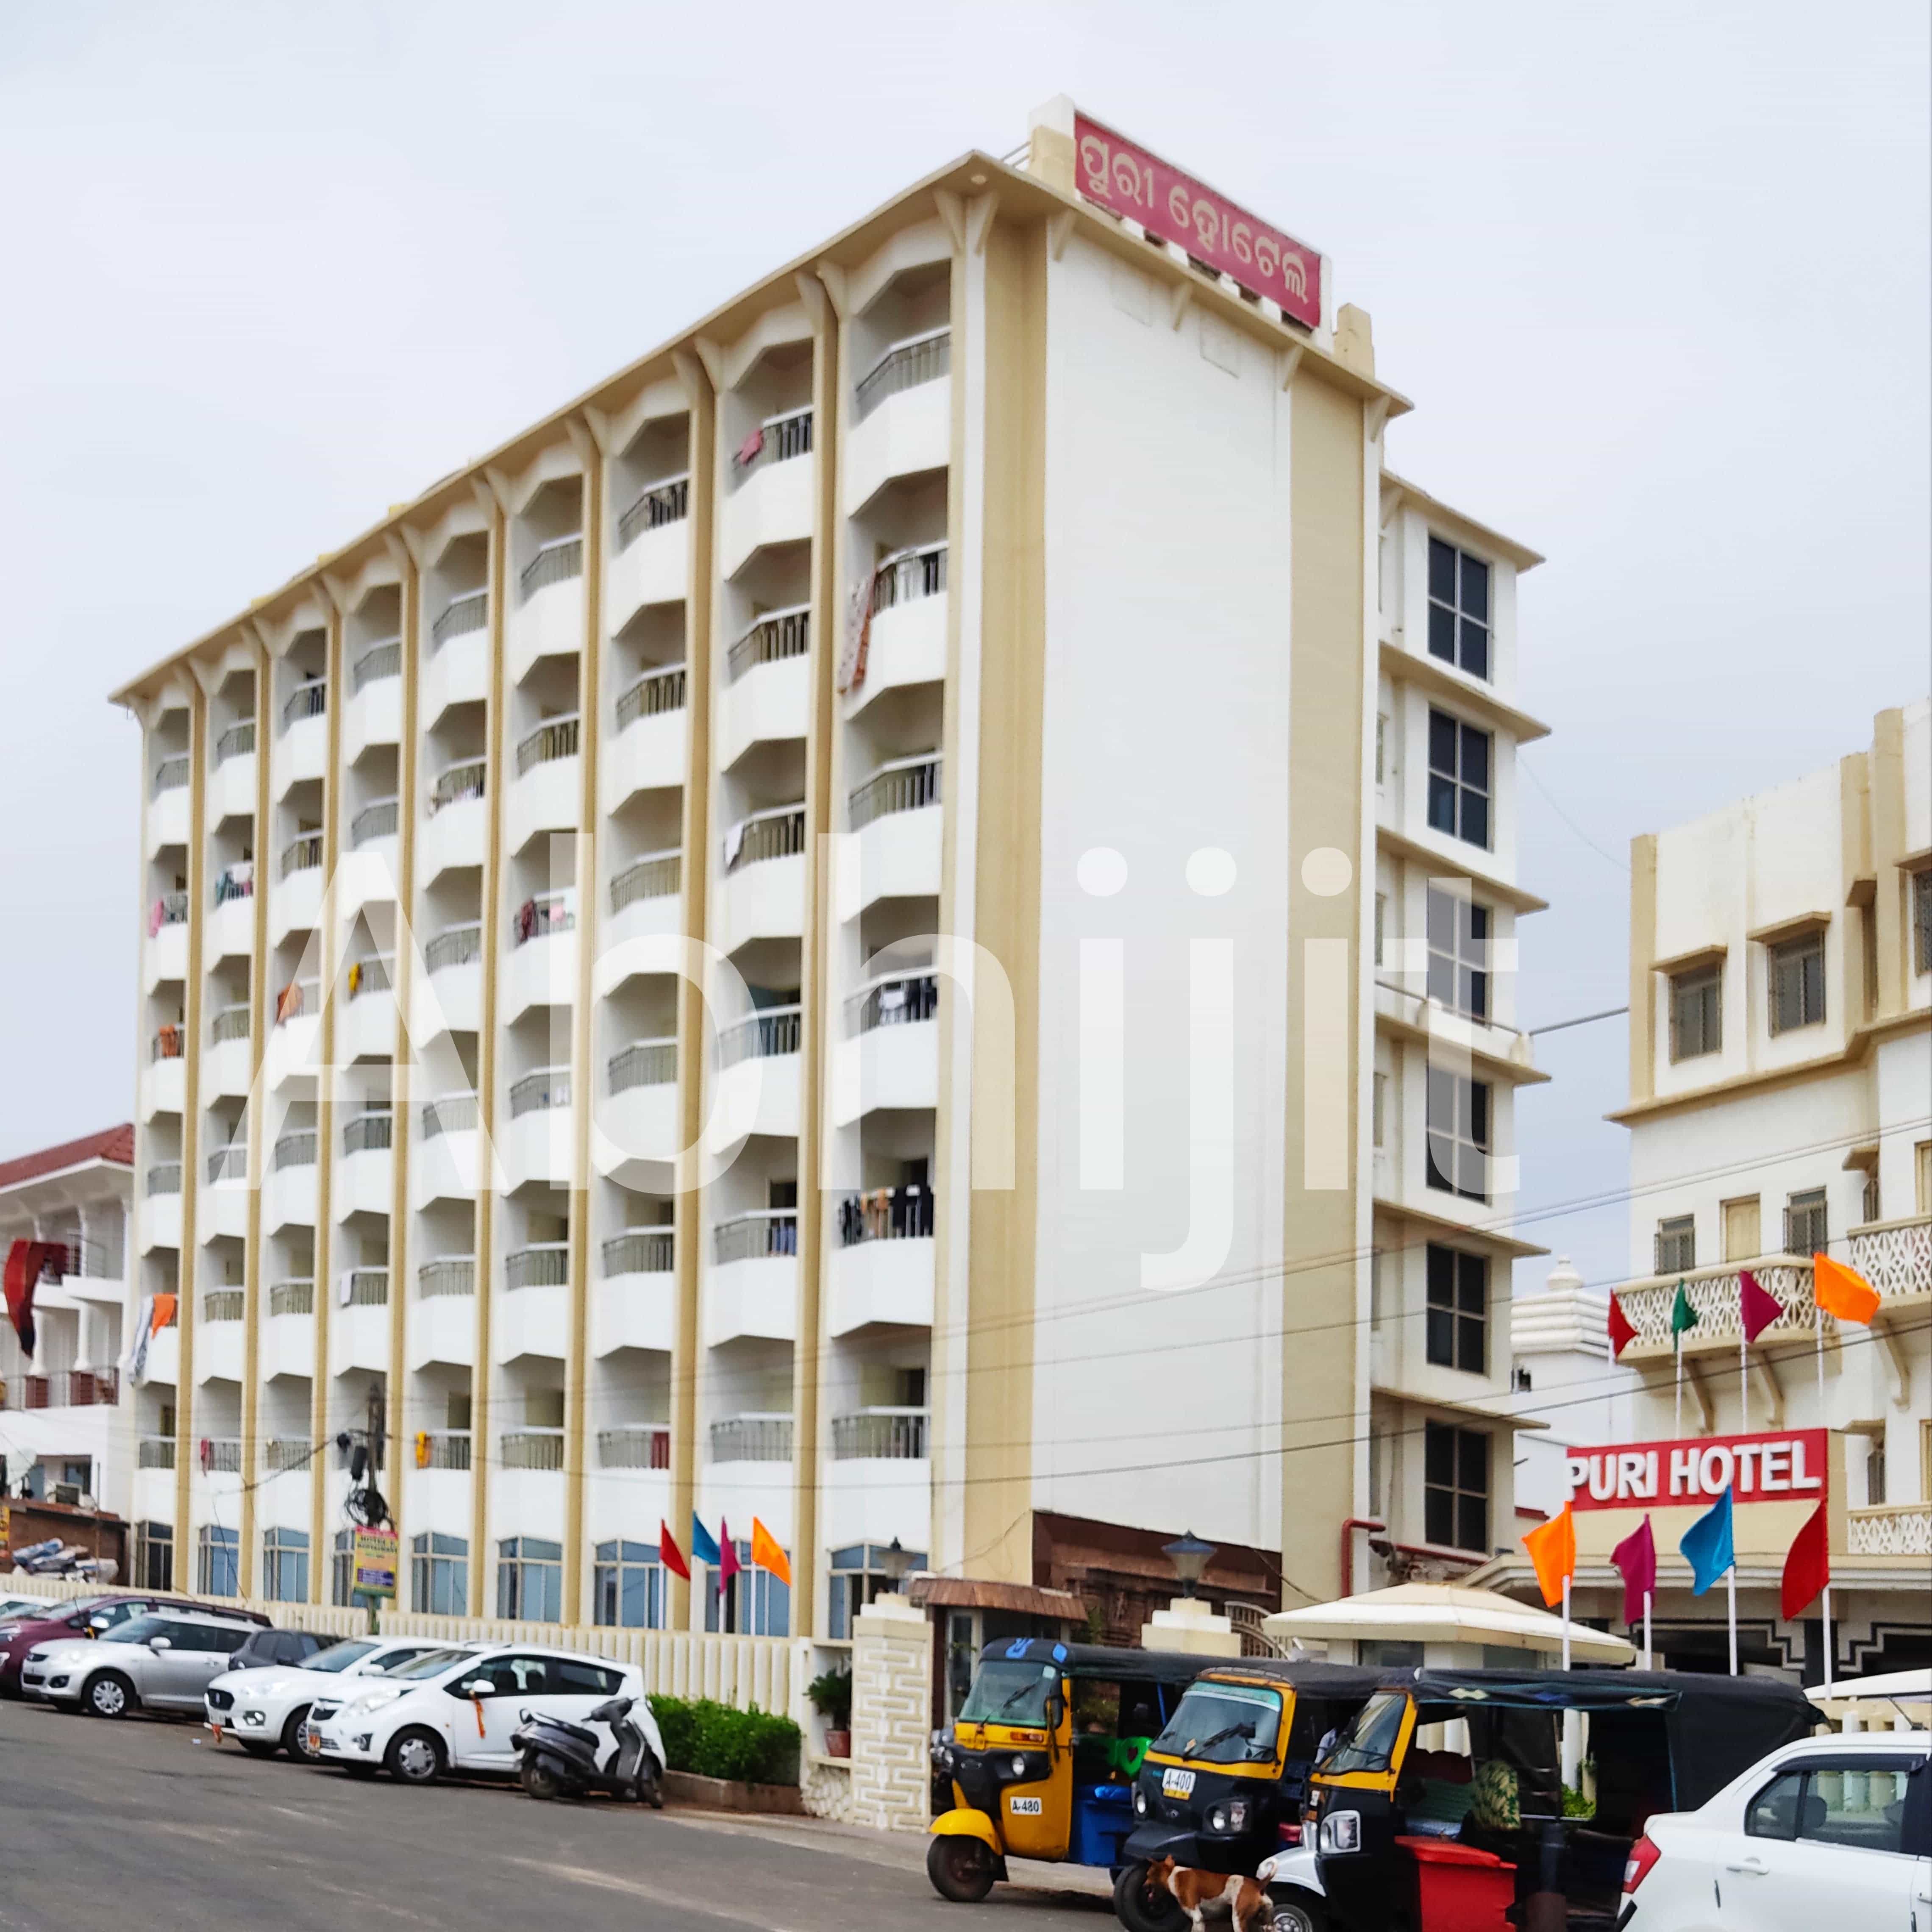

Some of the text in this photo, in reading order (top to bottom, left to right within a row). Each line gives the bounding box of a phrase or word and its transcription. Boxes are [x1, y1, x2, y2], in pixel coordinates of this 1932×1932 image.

[1080, 135, 1308, 303] ପୁରୀ ହୋଟେଲ
[1566, 1440, 1822, 1501] PURI HOTEL
[1165, 1771, 1192, 1790] A-400
[1012, 1800, 1040, 1812] A-480
